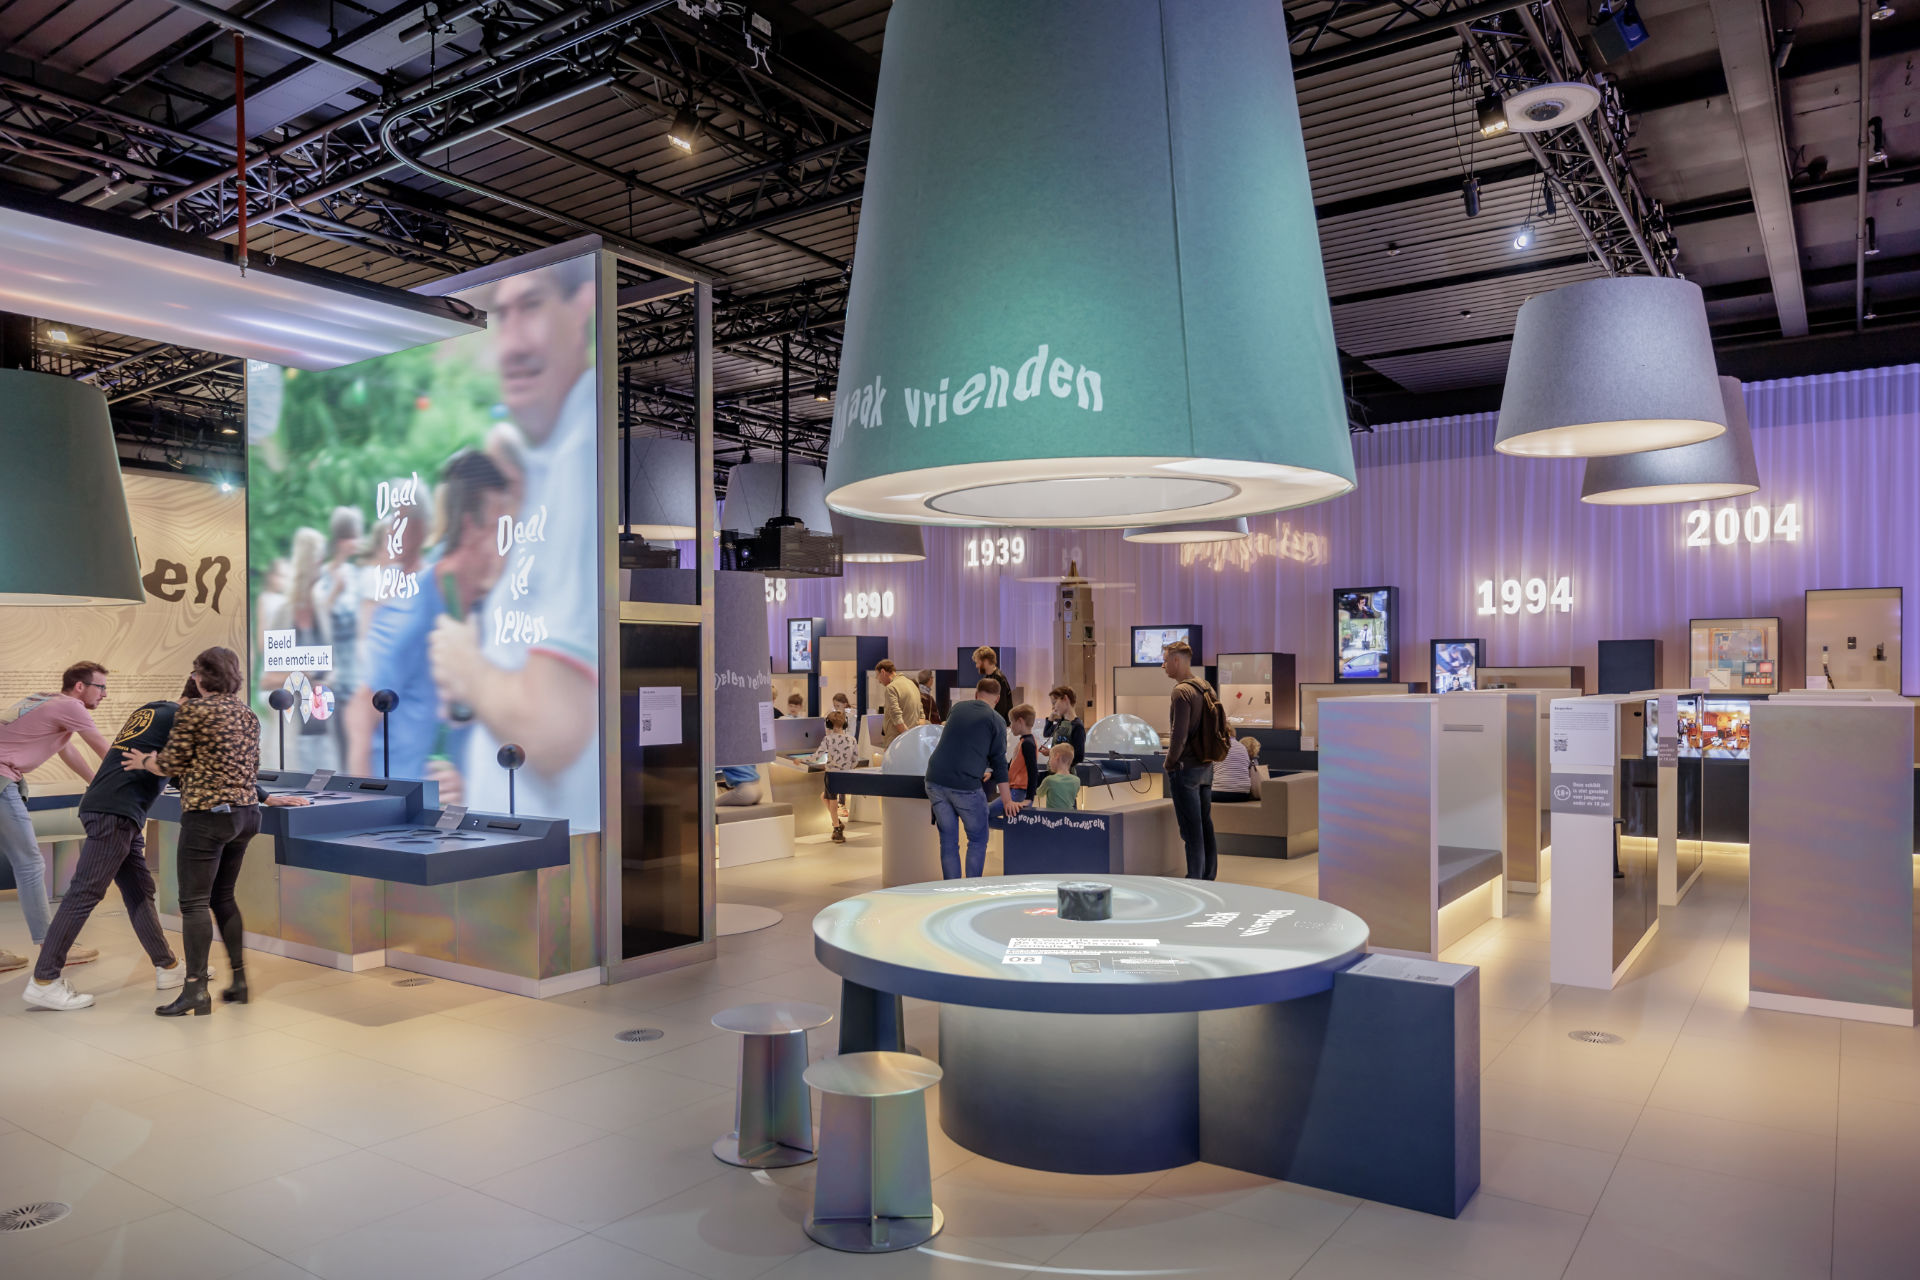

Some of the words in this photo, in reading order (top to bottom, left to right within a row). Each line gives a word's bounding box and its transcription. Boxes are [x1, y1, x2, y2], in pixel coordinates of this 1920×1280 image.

[904, 344, 1104, 428] vrienden
[376, 471, 418, 520] Deel
[497, 505, 547, 557] Deel
[1686, 503, 1801, 547] 2004
[966, 536, 1025, 567] 1939
[133, 536, 231, 615] en
[374, 564, 420, 602] leven
[843, 591, 894, 619] 1890
[1477, 576, 1574, 615] 1994
[268, 635, 292, 649] Beeld
[493, 606, 548, 646] leven
[268, 656, 283, 666] een
[285, 652, 315, 666] emotie
[317, 651, 329, 665] uit
